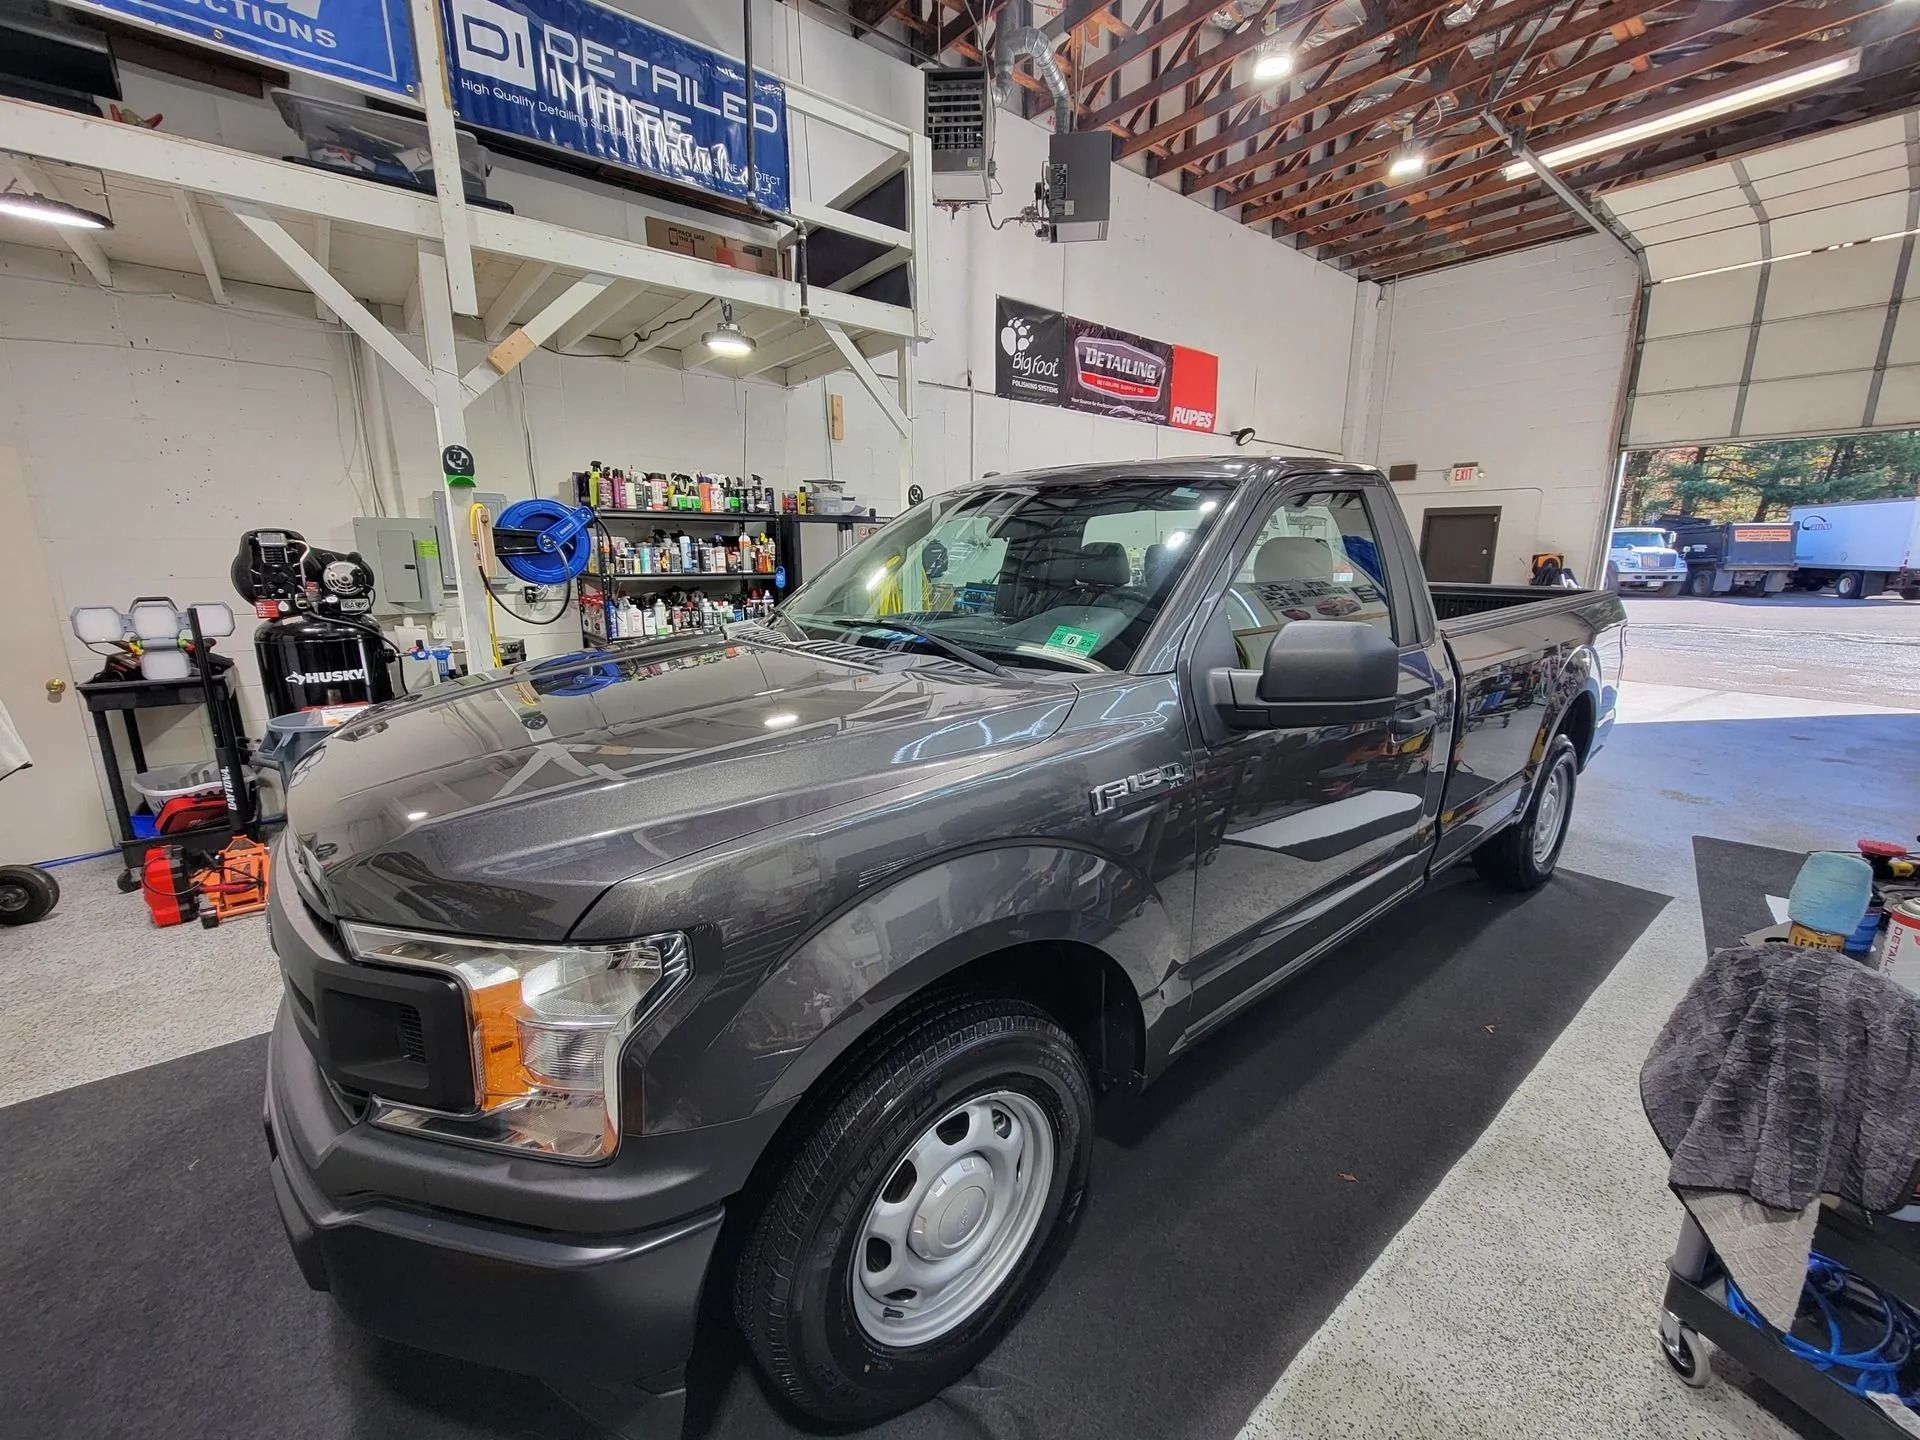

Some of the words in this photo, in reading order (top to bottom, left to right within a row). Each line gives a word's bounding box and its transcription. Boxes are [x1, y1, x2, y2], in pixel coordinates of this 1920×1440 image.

[187, 0, 338, 48] CTIONS
[543, 23, 778, 134] DETAILED
[461, 78, 490, 96] High
[493, 87, 536, 110] Quality
[538, 101, 588, 128] Detailing
[550, 68, 692, 141] IMAGE
[713, 158, 738, 173] SNE
[1085, 346, 1157, 379] DETAILING
[1011, 379, 1038, 390] POLISHING
[1038, 384, 1059, 394] SYSTEMS
[1096, 379, 1120, 389] DETAILING
[1120, 384, 1137, 392] SUPPLY
[1171, 406, 1213, 428] RUPES
[1455, 468, 1474, 481] EXIT
[1052, 633, 1064, 641] 20
[1067, 636, 1077, 645] 6
[1080, 639, 1092, 647] 25
[305, 668, 366, 685] HUSKY
[220, 767, 238, 811] DAYTONA
[1169, 781, 1183, 790] XL
[1884, 926, 1904, 967] DETAIL
